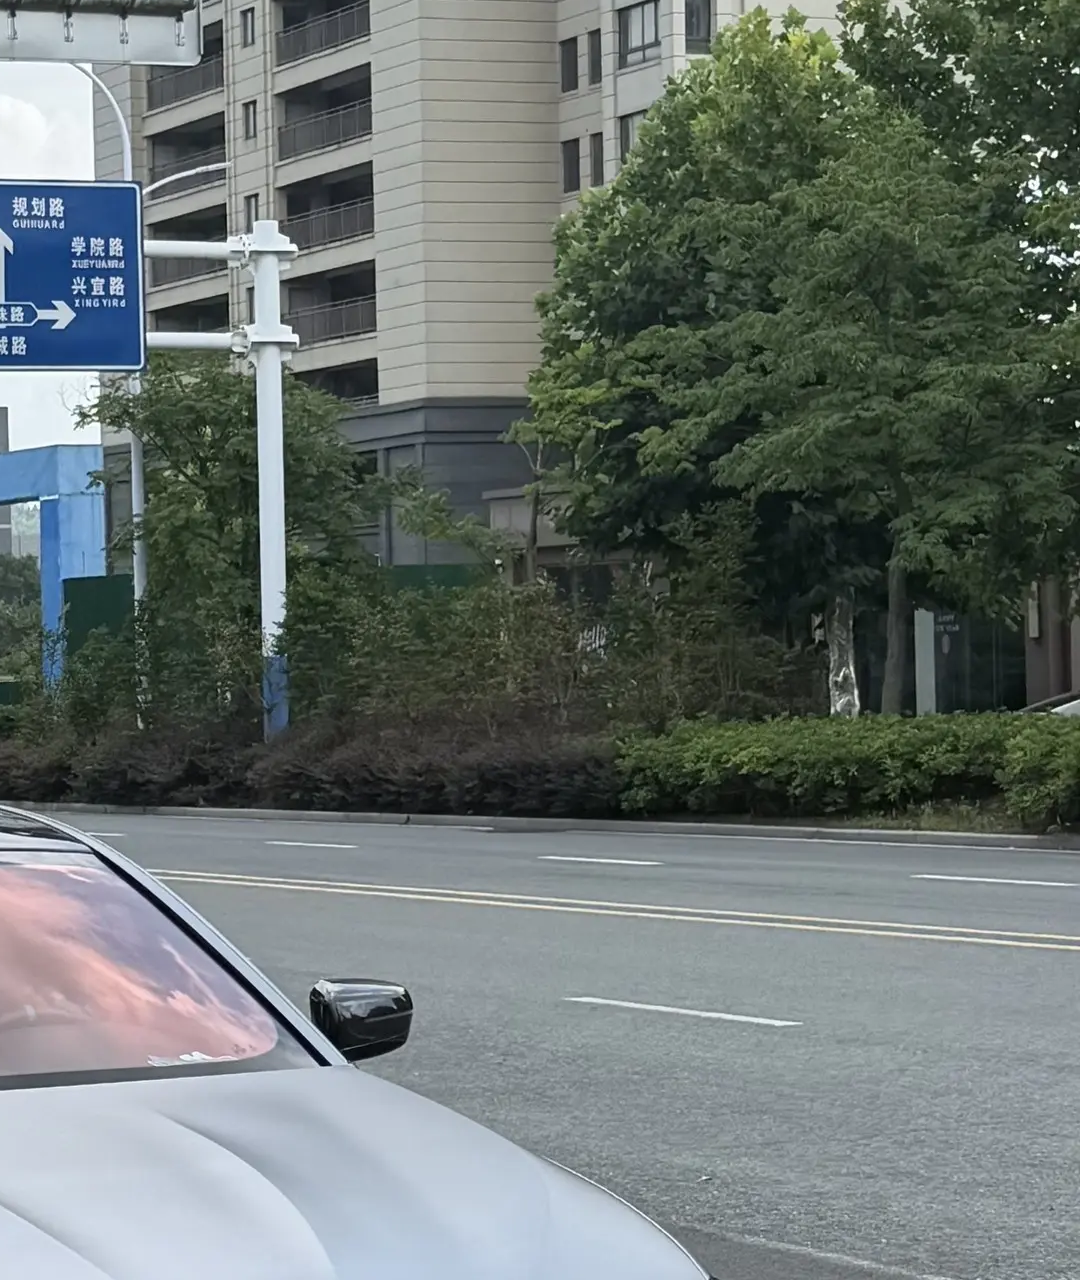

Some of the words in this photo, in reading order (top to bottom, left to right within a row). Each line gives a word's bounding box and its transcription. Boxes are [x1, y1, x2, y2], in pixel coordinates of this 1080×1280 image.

[12, 197, 64, 217] 规划路
[71, 236, 124, 256] 学院路
